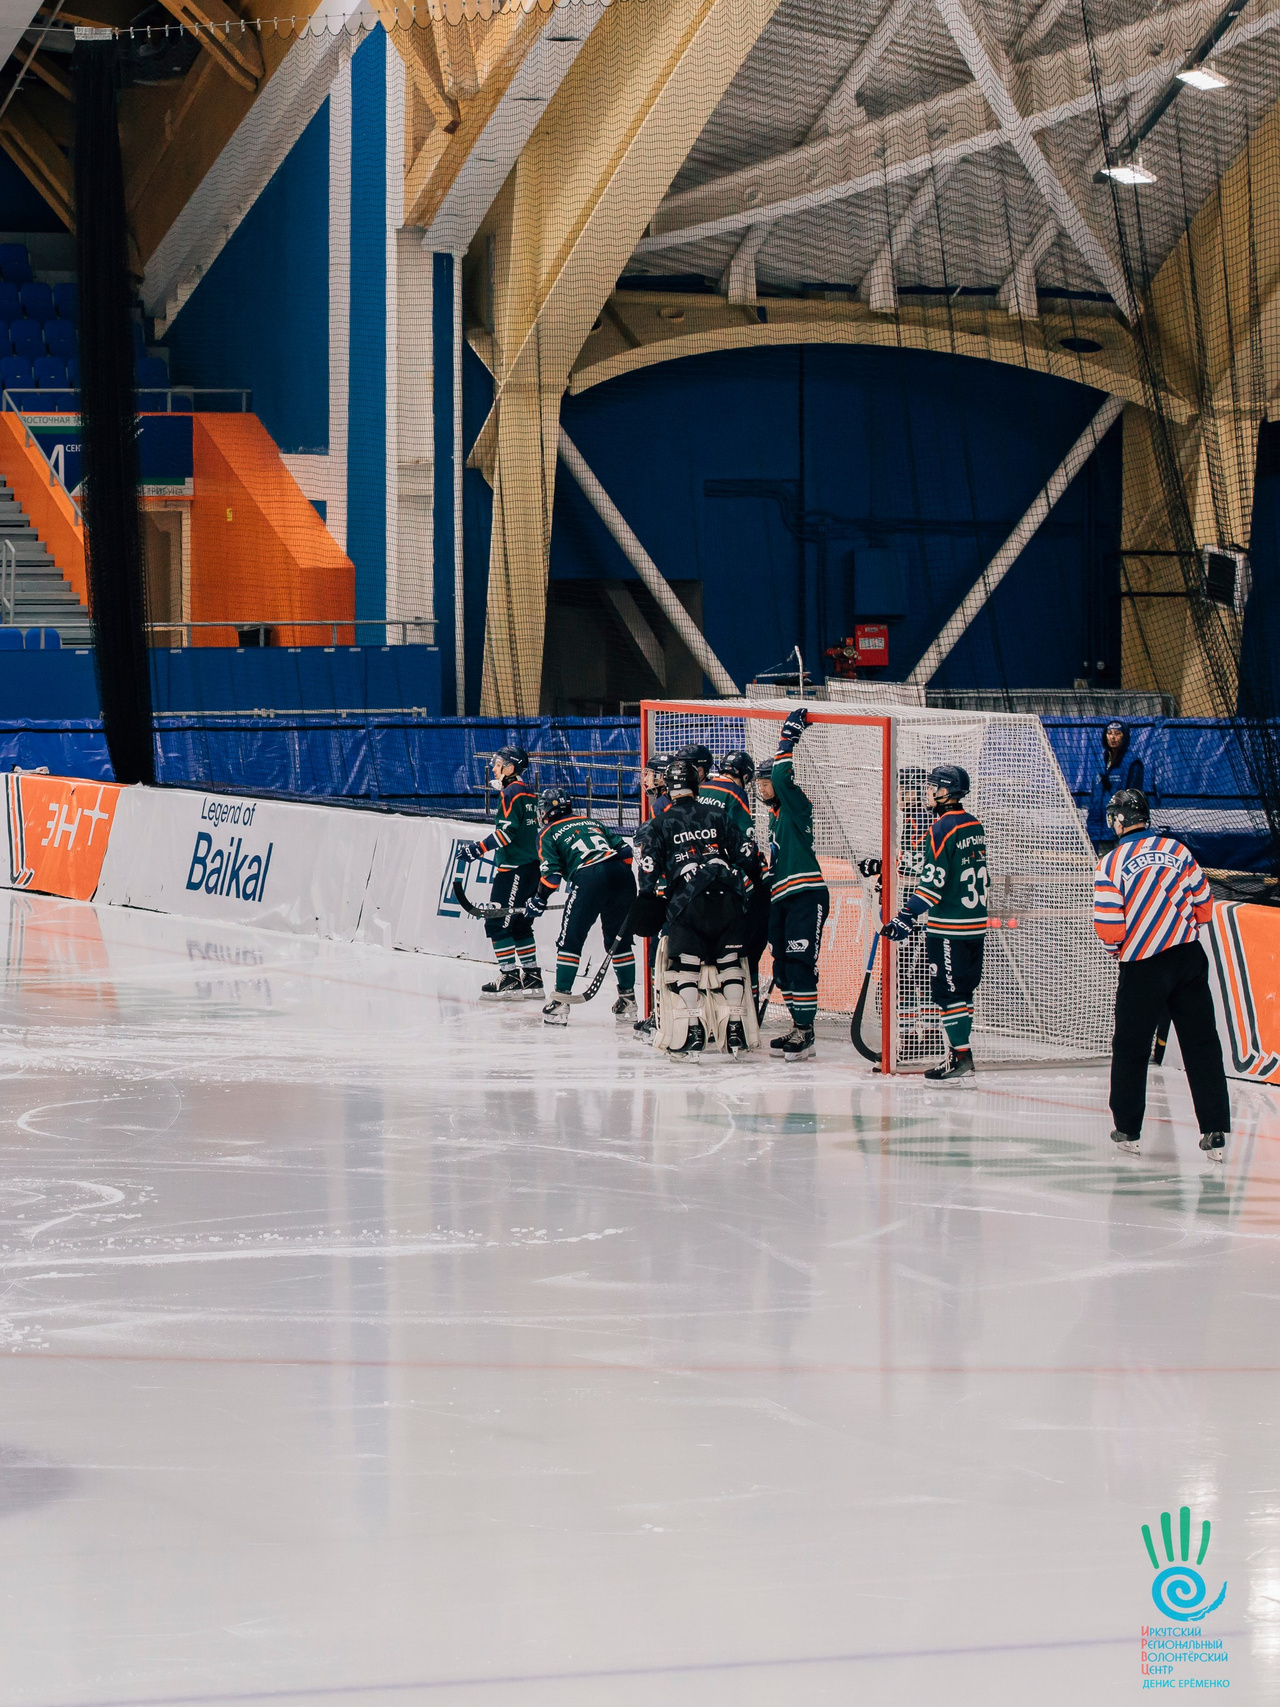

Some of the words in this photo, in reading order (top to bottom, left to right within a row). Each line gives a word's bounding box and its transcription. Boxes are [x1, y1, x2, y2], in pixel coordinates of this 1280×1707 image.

[201, 797, 244, 827] Legend
[242, 803, 257, 826] of
[499, 819, 512, 830] 7
[673, 828, 718, 845] СПАСОВ
[185, 831, 274, 903] Baikal
[921, 862, 946, 888] 33
[1122, 852, 1184, 881] LEBEDEV
[959, 866, 988, 909] 33
[891, 916, 913, 933] CCM
